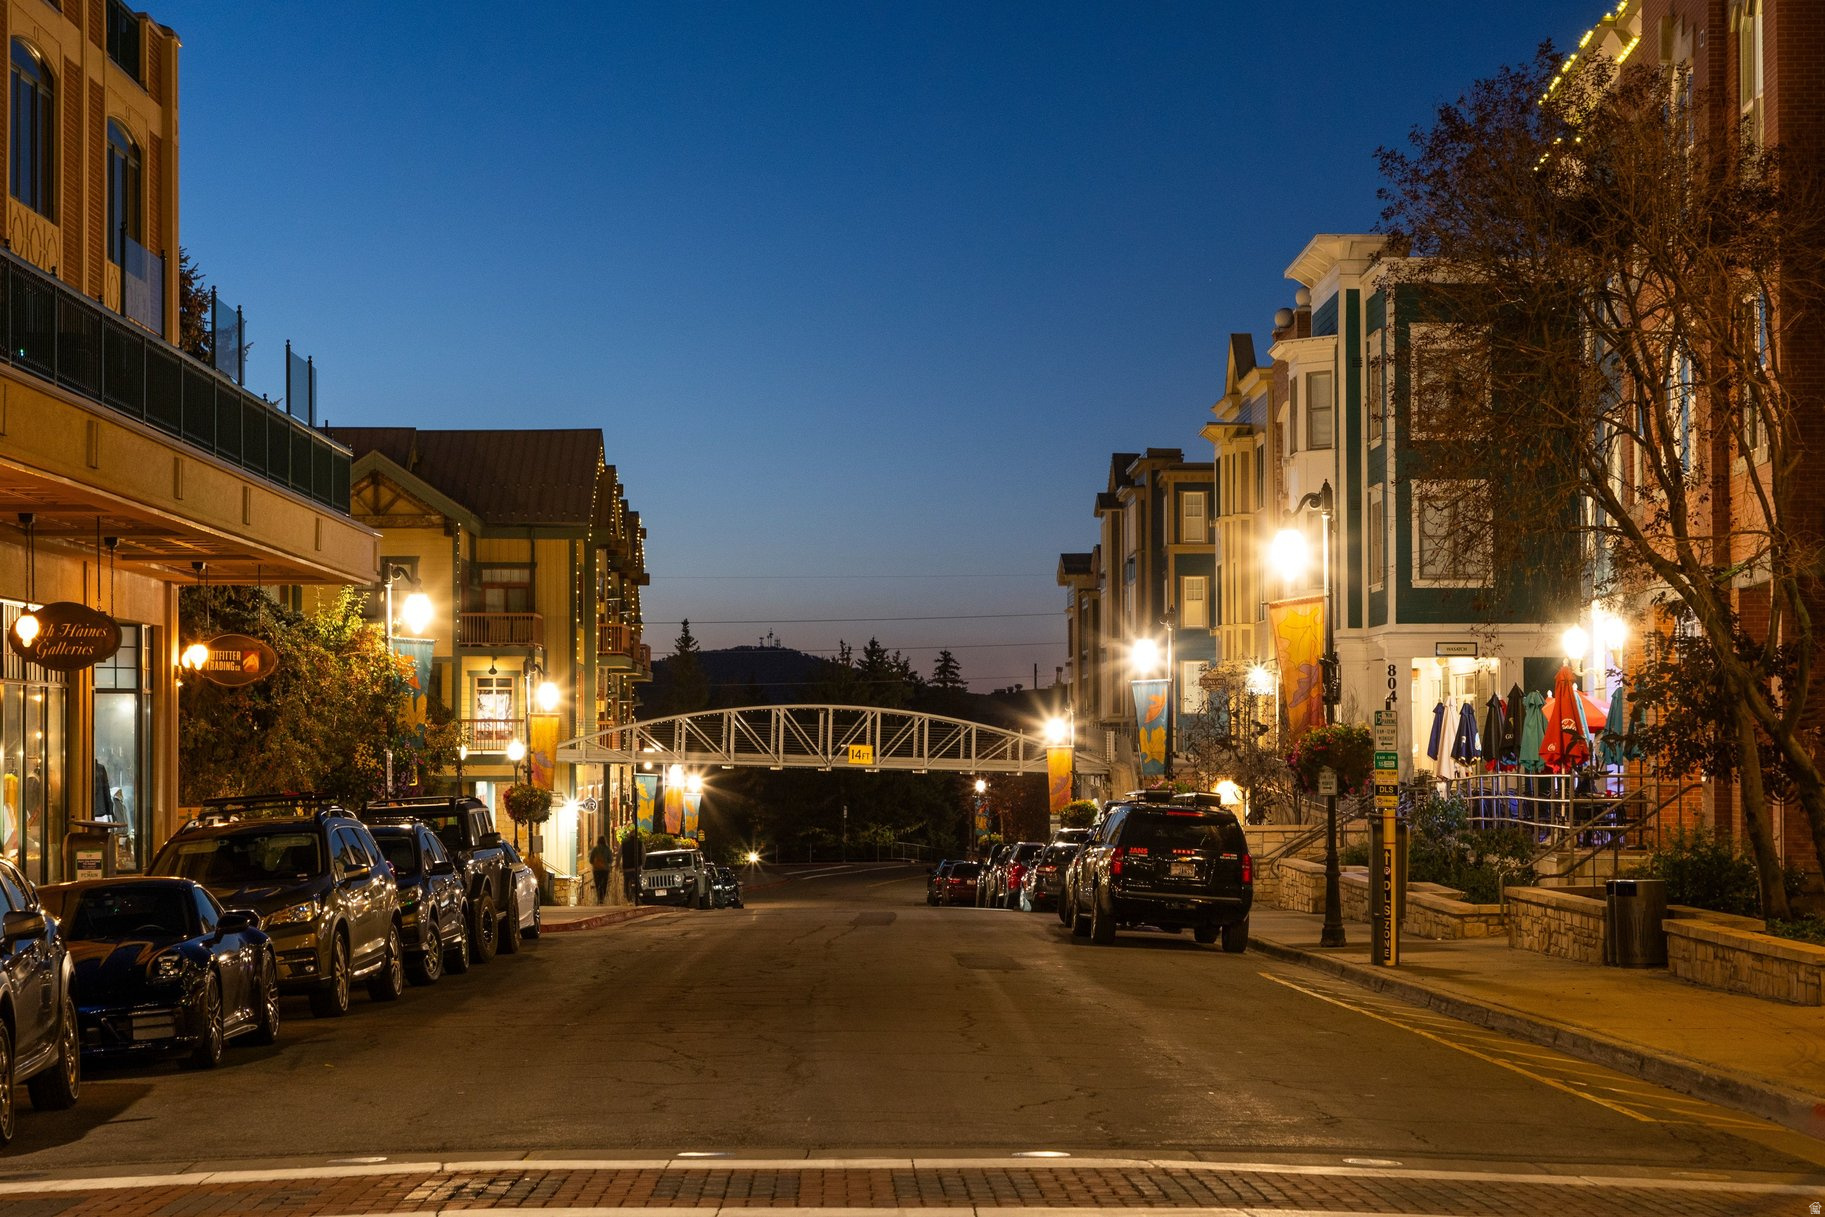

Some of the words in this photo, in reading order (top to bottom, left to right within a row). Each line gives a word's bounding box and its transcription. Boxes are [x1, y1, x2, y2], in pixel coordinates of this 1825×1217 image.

[60, 623, 107, 637] Haines
[36, 639, 94, 659] Galleries
[206, 661, 235, 671] TRADING
[1387, 664, 1397, 702] 804
[1379, 785, 1394, 793] DLS
[1383, 880, 1391, 916] DLS
[1383, 921, 1391, 958] ZONE
